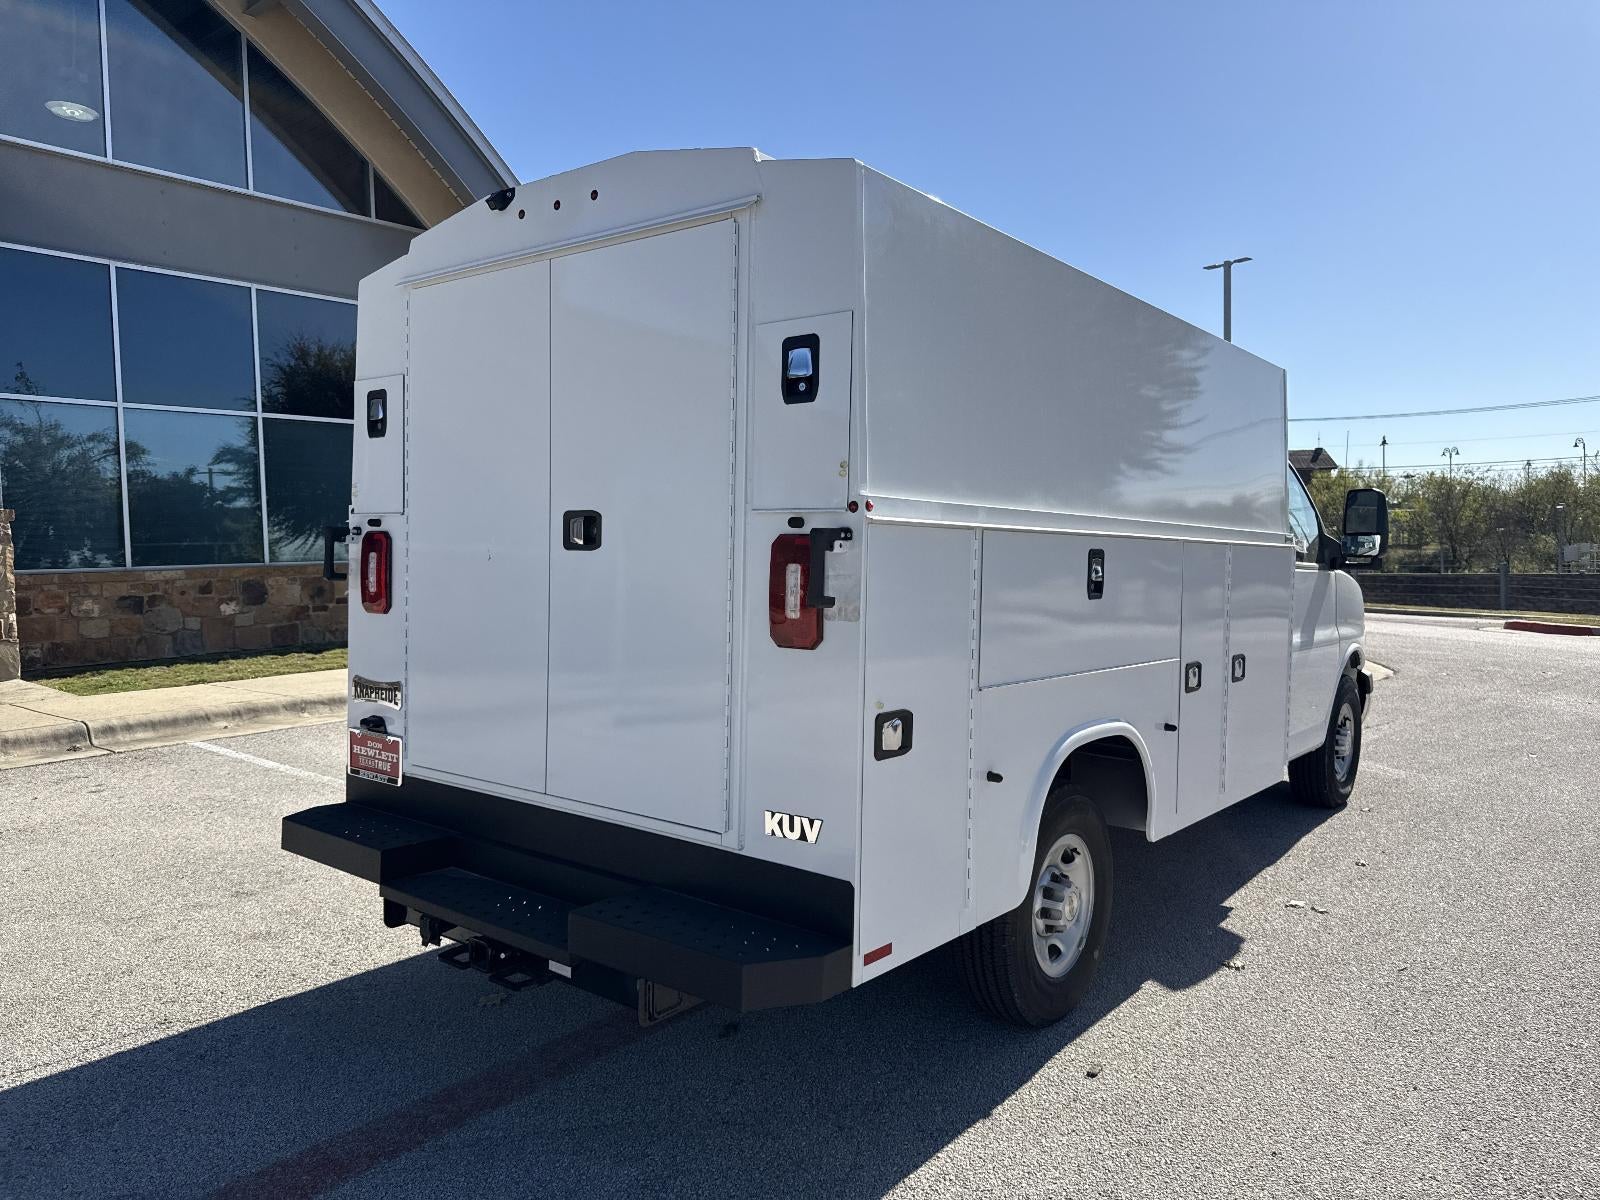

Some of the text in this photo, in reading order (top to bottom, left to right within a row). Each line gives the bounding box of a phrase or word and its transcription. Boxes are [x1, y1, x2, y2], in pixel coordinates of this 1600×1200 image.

[353, 680, 400, 706] KNAPHEIDE
[353, 745, 399, 762] HEWLETT
[367, 741, 383, 750] DON
[764, 809, 823, 844] KUV
